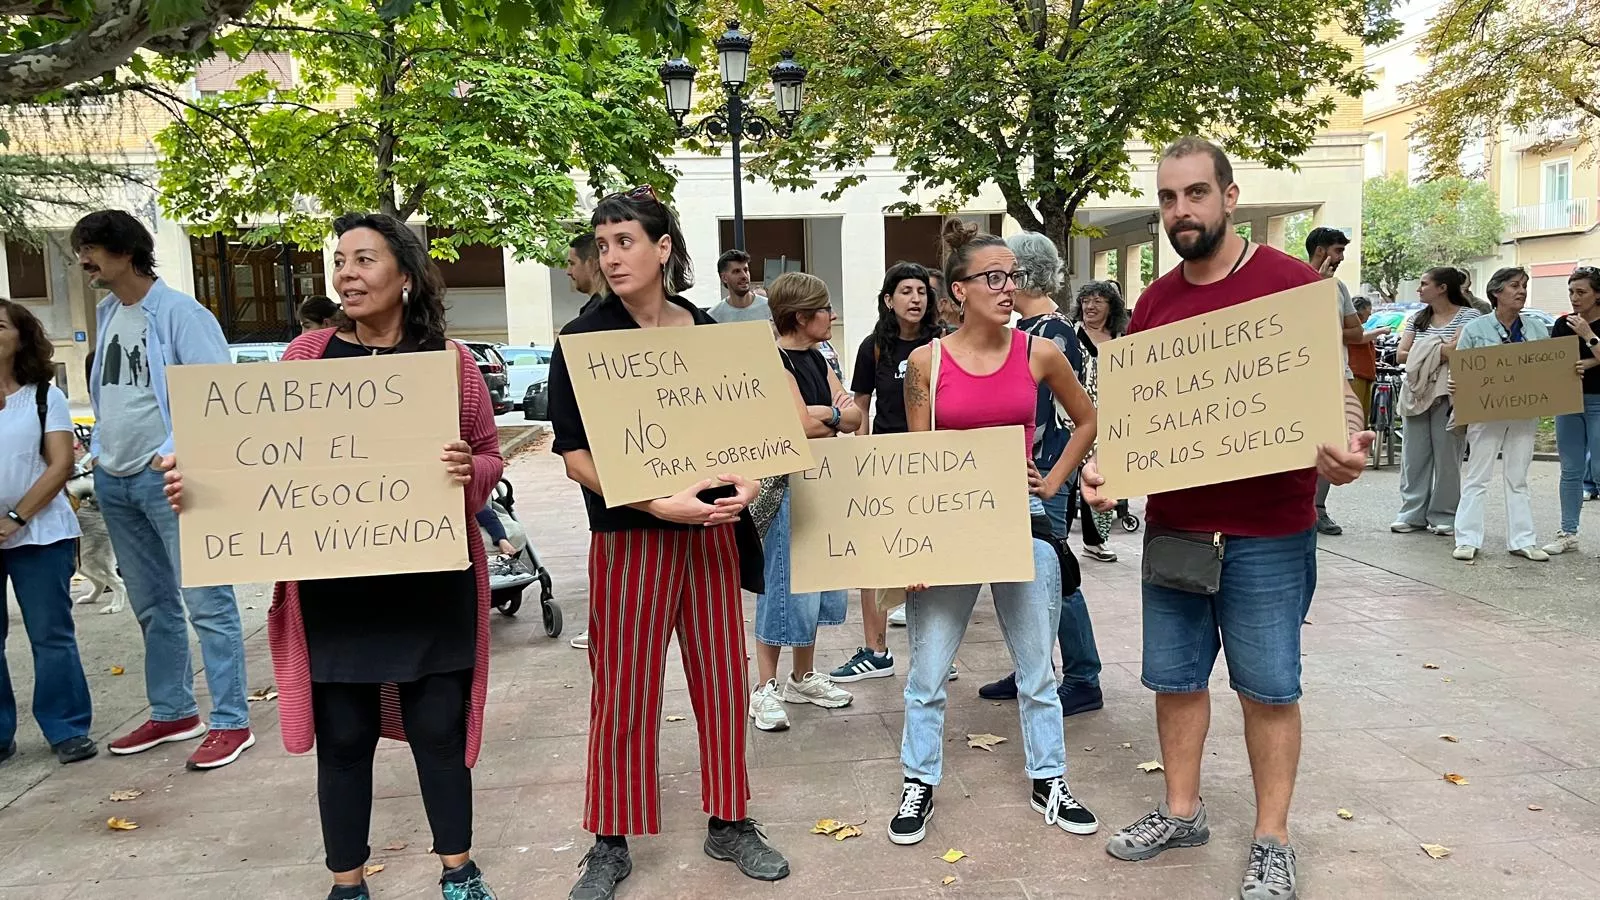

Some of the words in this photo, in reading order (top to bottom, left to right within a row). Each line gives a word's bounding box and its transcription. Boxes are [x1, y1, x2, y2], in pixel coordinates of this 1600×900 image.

[1145, 313, 1284, 364] ALQUILERES
[587, 350, 689, 381] HUESCA
[1131, 380, 1168, 403] POR
[1176, 369, 1215, 395] LAS
[1224, 346, 1311, 385] NUBES
[1460, 355, 1487, 372] NO
[1496, 358, 1513, 368] AL
[1518, 350, 1566, 364] NEGOCIO
[204, 374, 404, 418] ACABEMOS
[656, 386, 708, 409] PARA
[712, 372, 767, 402] VIVIR
[1480, 376, 1495, 388] DE
[1503, 375, 1515, 383] LA
[1145, 392, 1267, 435] SALARIOS
[1479, 393, 1549, 411] VIVIENDA
[625, 408, 668, 455] NO
[1126, 449, 1164, 473] POR
[1170, 440, 1205, 465] LOS
[1216, 421, 1305, 457] SUELOS
[236, 436, 303, 466] CON
[330, 435, 369, 460] EL
[643, 456, 697, 479] PARA
[705, 436, 801, 468] SOBREVIVIR
[854, 447, 977, 477] VIVIENDA
[258, 475, 410, 512] NEGOCIO
[846, 495, 895, 519] NOS
[907, 489, 995, 515] CUESTA
[205, 533, 244, 560] DE
[260, 531, 293, 556] LA
[314, 515, 456, 553] VIVIENDA
[828, 533, 857, 558] LA
[881, 527, 934, 559] VIDA
